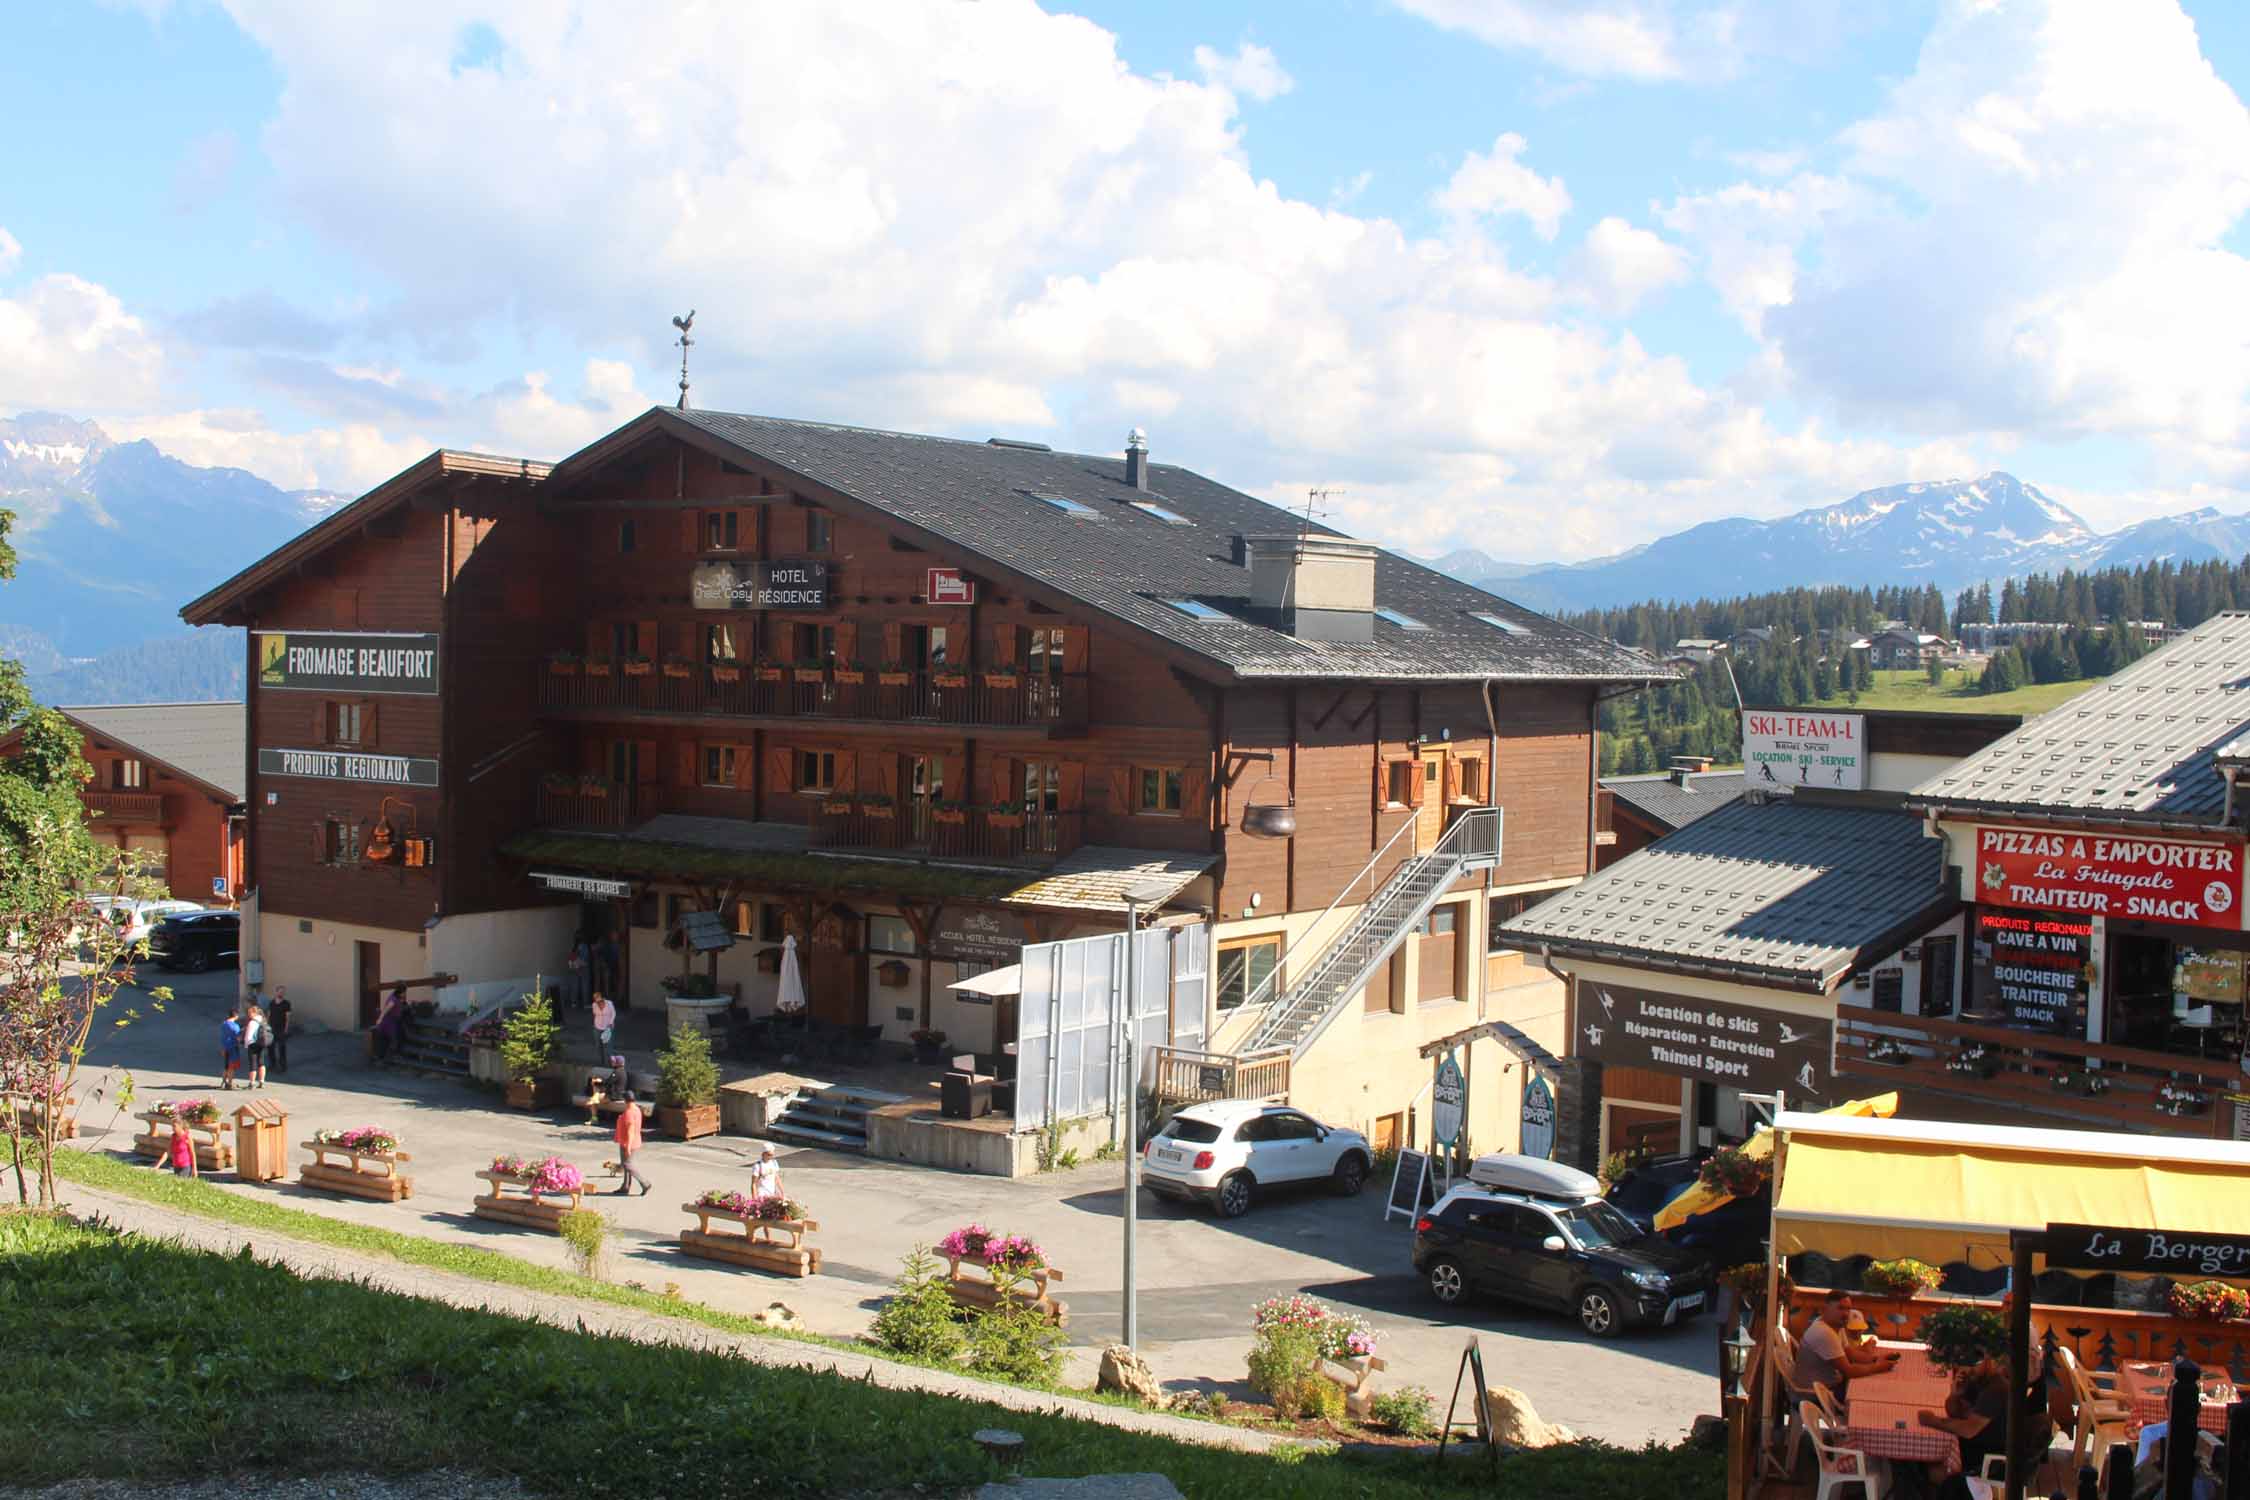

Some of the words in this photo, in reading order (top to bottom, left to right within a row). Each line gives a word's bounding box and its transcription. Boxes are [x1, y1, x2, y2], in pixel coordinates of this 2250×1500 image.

[771, 569, 809, 583] HOTEL
[724, 588, 753, 602] Cosy
[288, 647, 355, 676] FROMAGE
[358, 649, 434, 678] BEAUFORT
[283, 752, 338, 777] PRODUITS
[344, 756, 411, 782] REGIONAUX
[1751, 751, 1793, 763] LOCATION
[1798, 754, 1813, 766] SKI
[1820, 755, 1857, 768] SERVICE
[1983, 831, 2065, 857] PIZZAS
[2071, 838, 2087, 860] A
[2094, 839, 2234, 873] EMPORTER
[2033, 861, 2067, 881] La
[2073, 865, 2175, 891] Fringale
[2008, 885, 2109, 912] TRAITEUR
[2126, 896, 2200, 920] SNACK
[1981, 916, 2030, 933] PRODUITS
[2034, 921, 2095, 936] REGIONAUX
[1996, 930, 2036, 949] CAVE
[2037, 934, 2048, 949] A
[2049, 935, 2078, 953] VIN
[1994, 965, 2077, 989] BOUCHERIE
[2001, 986, 2068, 1008] TRAITEUR
[1639, 1000, 1703, 1026] Location
[1706, 1012, 1725, 1029] de
[1727, 1015, 1760, 1034] skis
[2014, 1006, 2055, 1023] SNACK
[1624, 1020, 1698, 1045] Réparation
[1709, 1035, 1776, 1060] Entretien
[1651, 1045, 1702, 1069] Thimel
[1705, 1055, 1750, 1078] Sport
[2084, 1231, 2122, 1257] La
